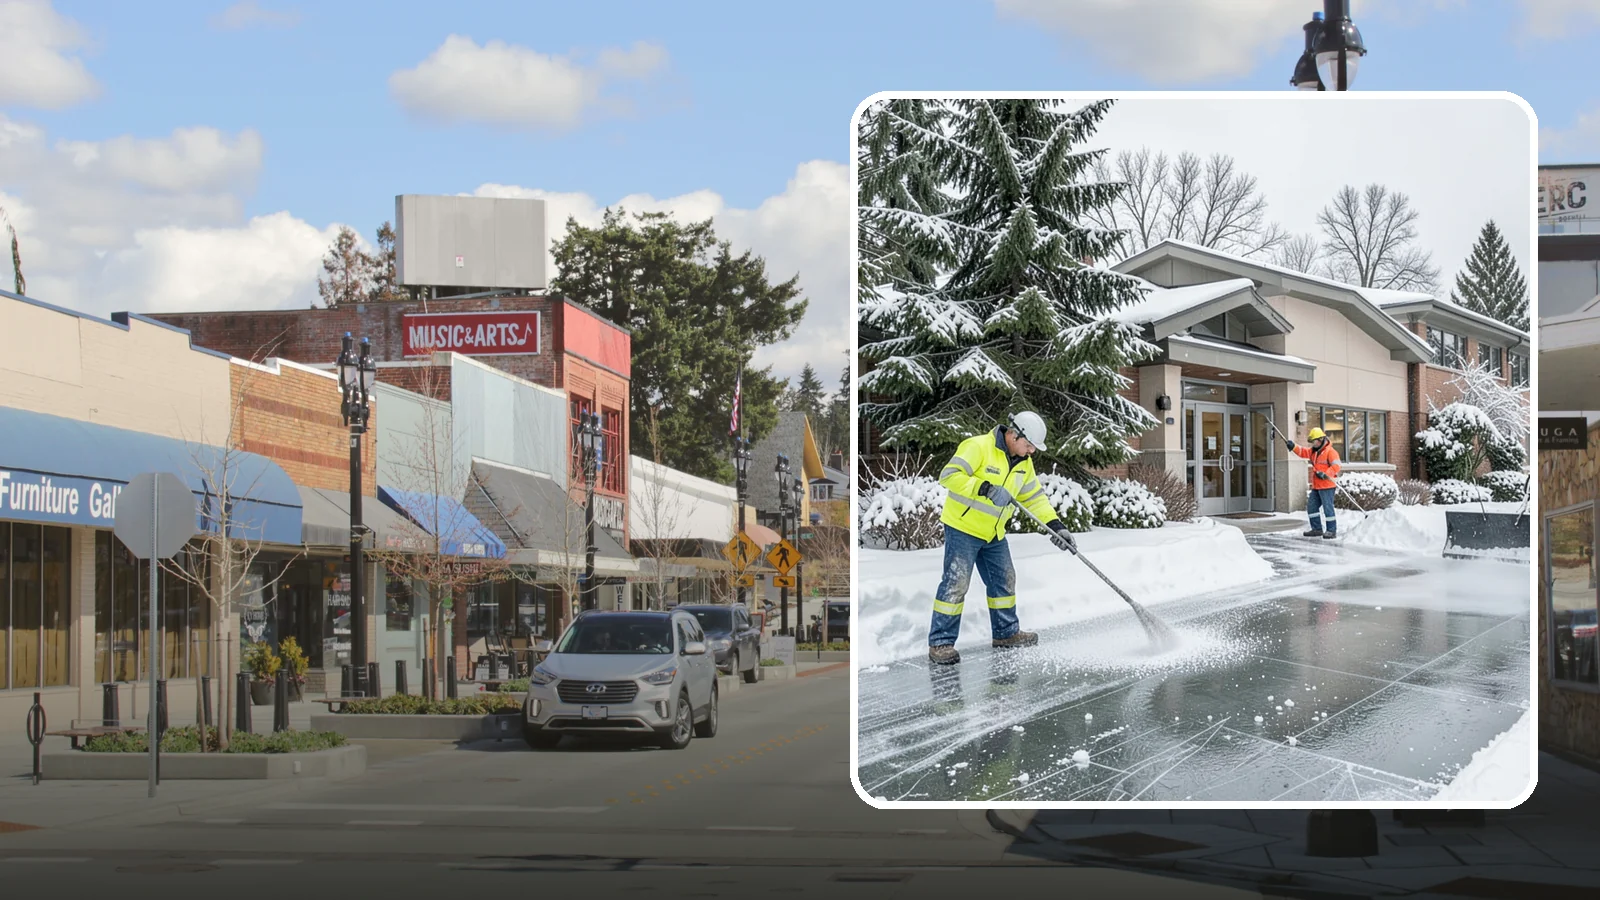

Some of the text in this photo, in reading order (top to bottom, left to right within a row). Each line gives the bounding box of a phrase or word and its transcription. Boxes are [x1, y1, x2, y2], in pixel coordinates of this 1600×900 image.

[409, 323, 519, 349] MUSIC&ARTS
[1551, 436, 1579, 445] Framing
[0, 471, 79, 515] Furniture
